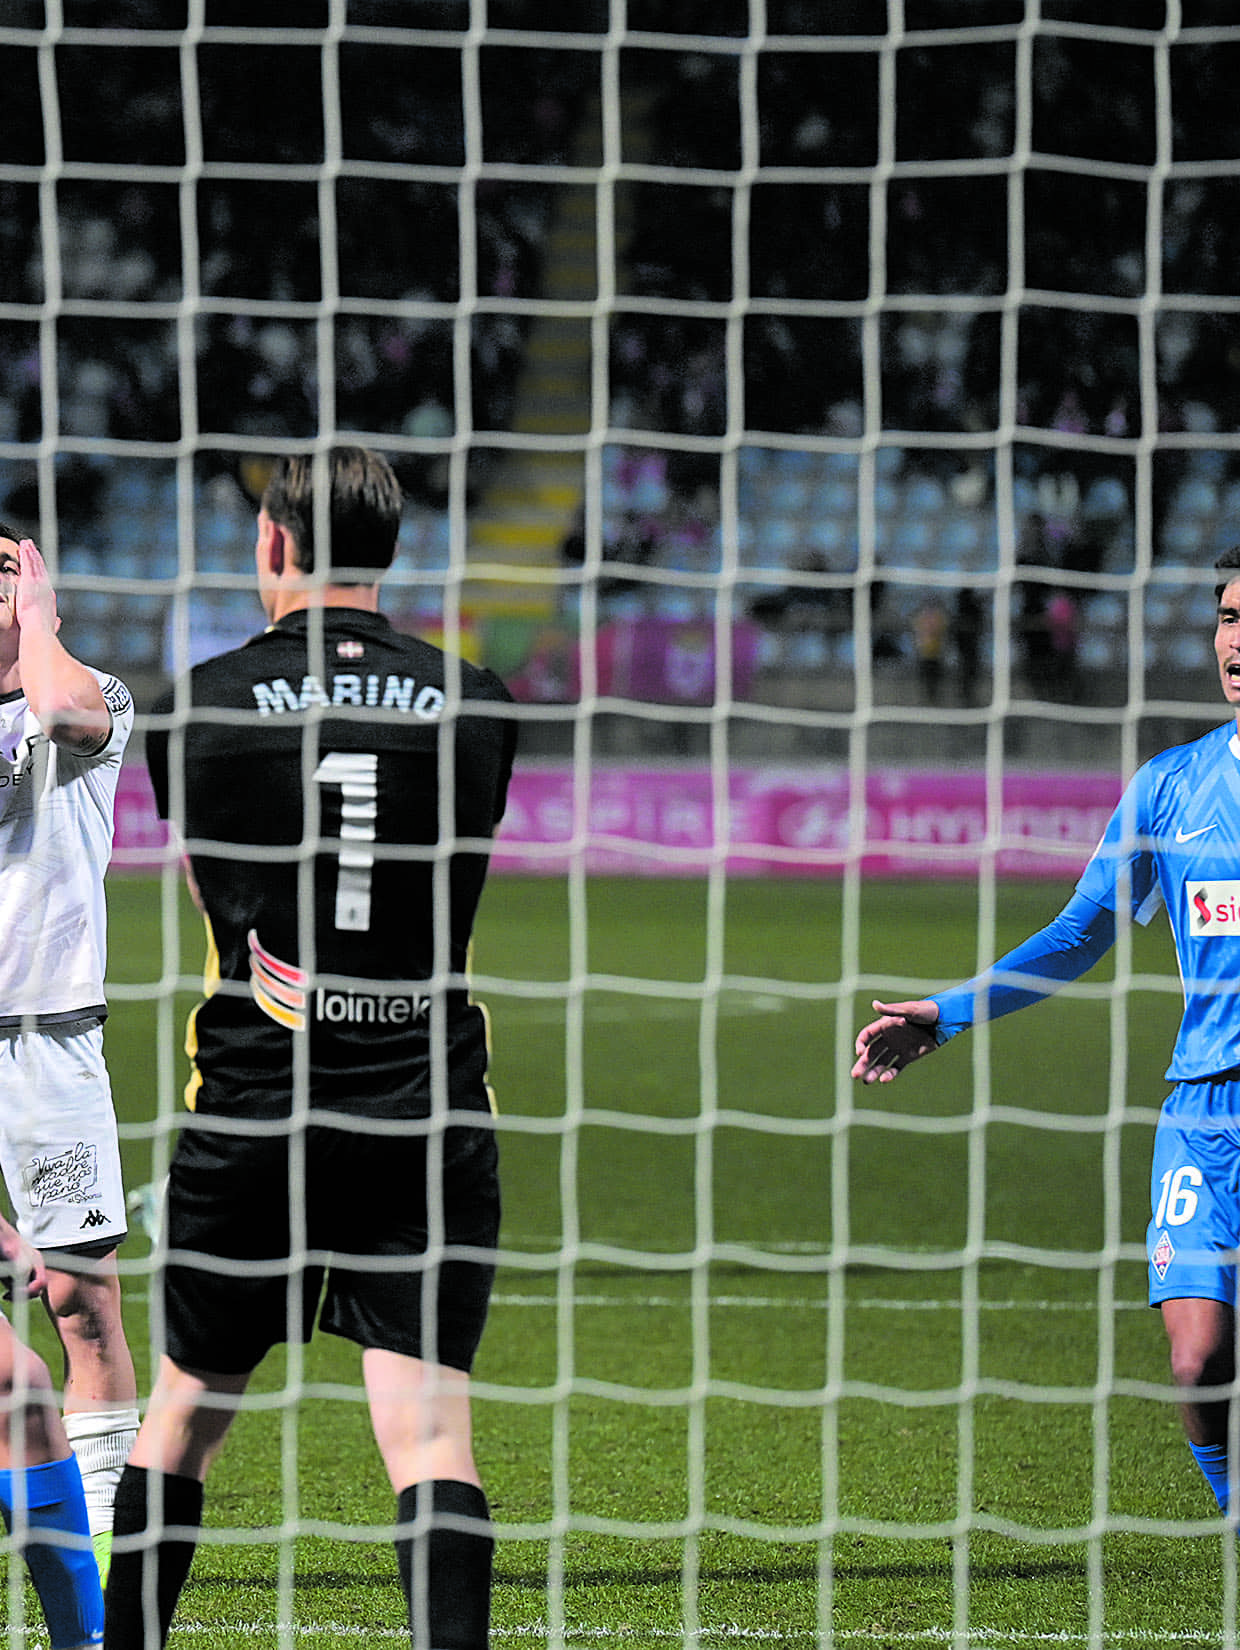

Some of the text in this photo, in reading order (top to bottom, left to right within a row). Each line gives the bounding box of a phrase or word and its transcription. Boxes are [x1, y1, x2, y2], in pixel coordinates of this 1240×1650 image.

[252, 674, 445, 720] MARINO
[312, 751, 378, 931] 1
[316, 987, 431, 1024] lointek
[32, 1156, 89, 1186] madre
[74, 1141, 92, 1162] la
[1155, 1165, 1203, 1229] 16
